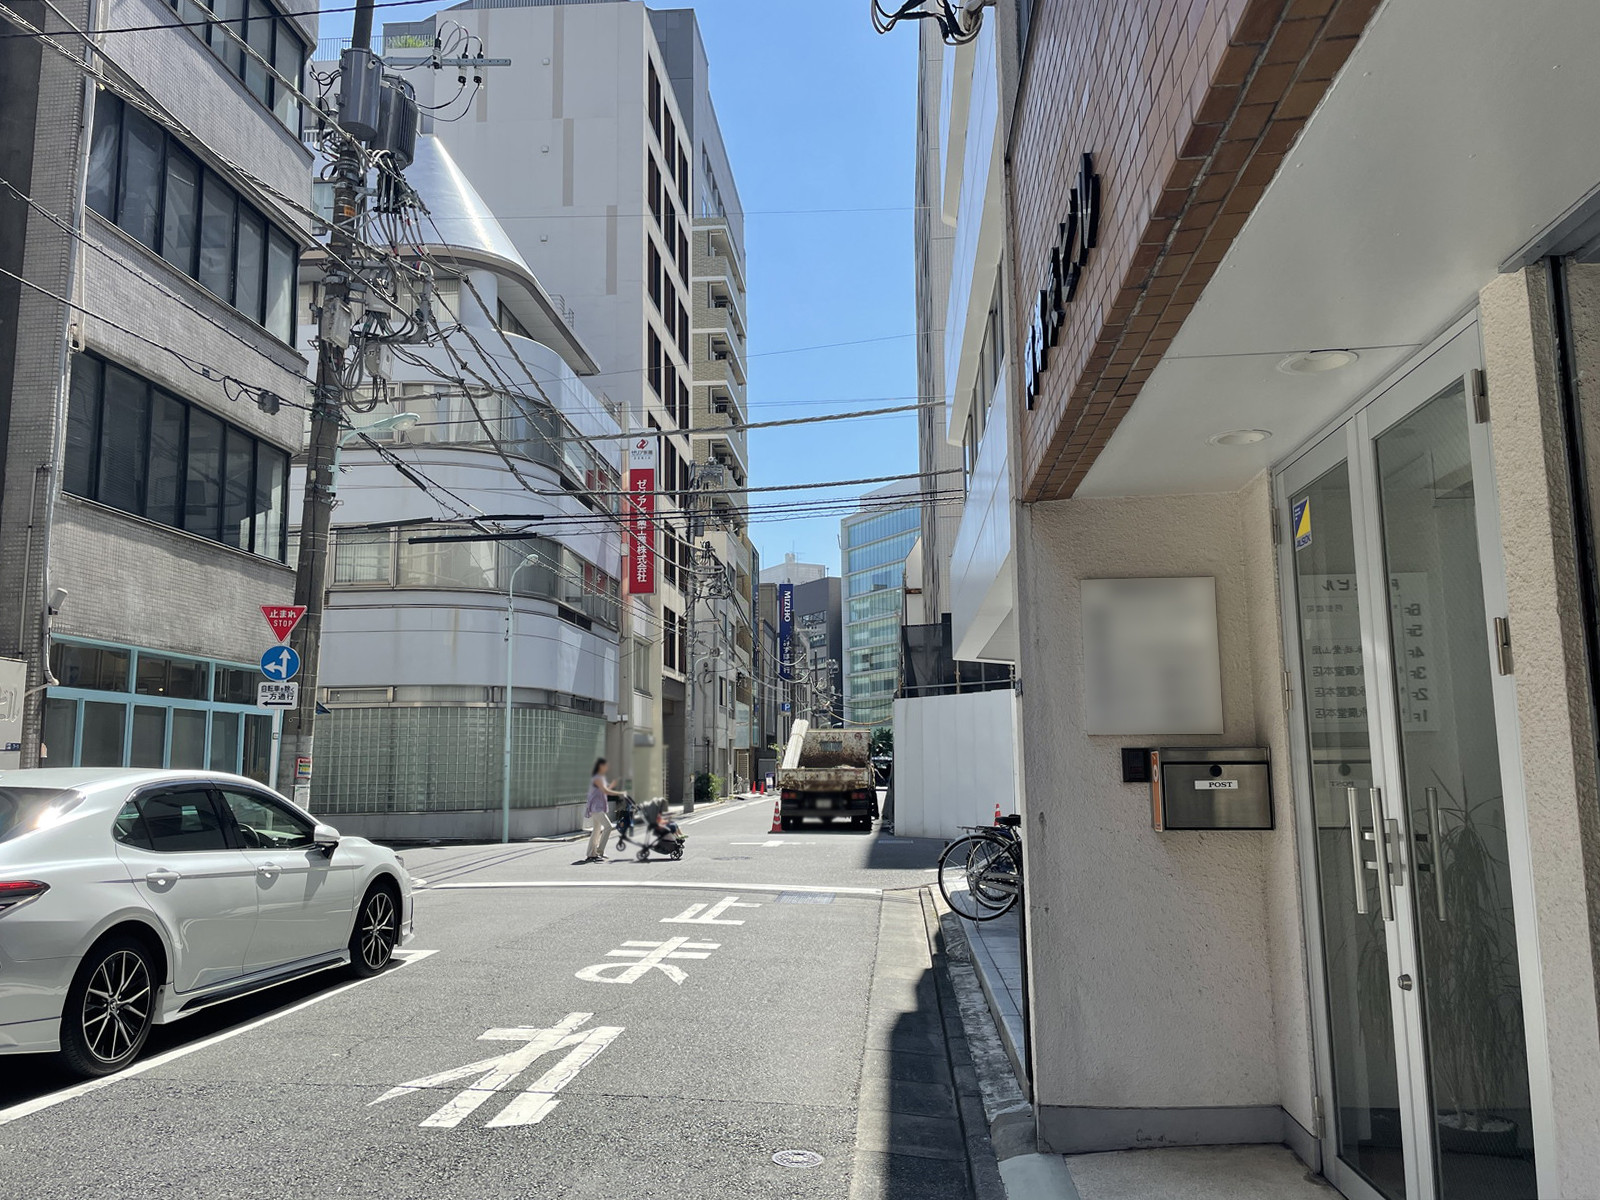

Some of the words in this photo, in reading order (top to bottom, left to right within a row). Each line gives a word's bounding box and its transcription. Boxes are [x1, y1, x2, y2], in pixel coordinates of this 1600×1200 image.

[269, 610, 297, 619] 止まれ
[261, 685, 295, 693] 自転車を除く
[261, 693, 294, 701] 一方通行
[367, 896, 763, 1129] 止まれ
